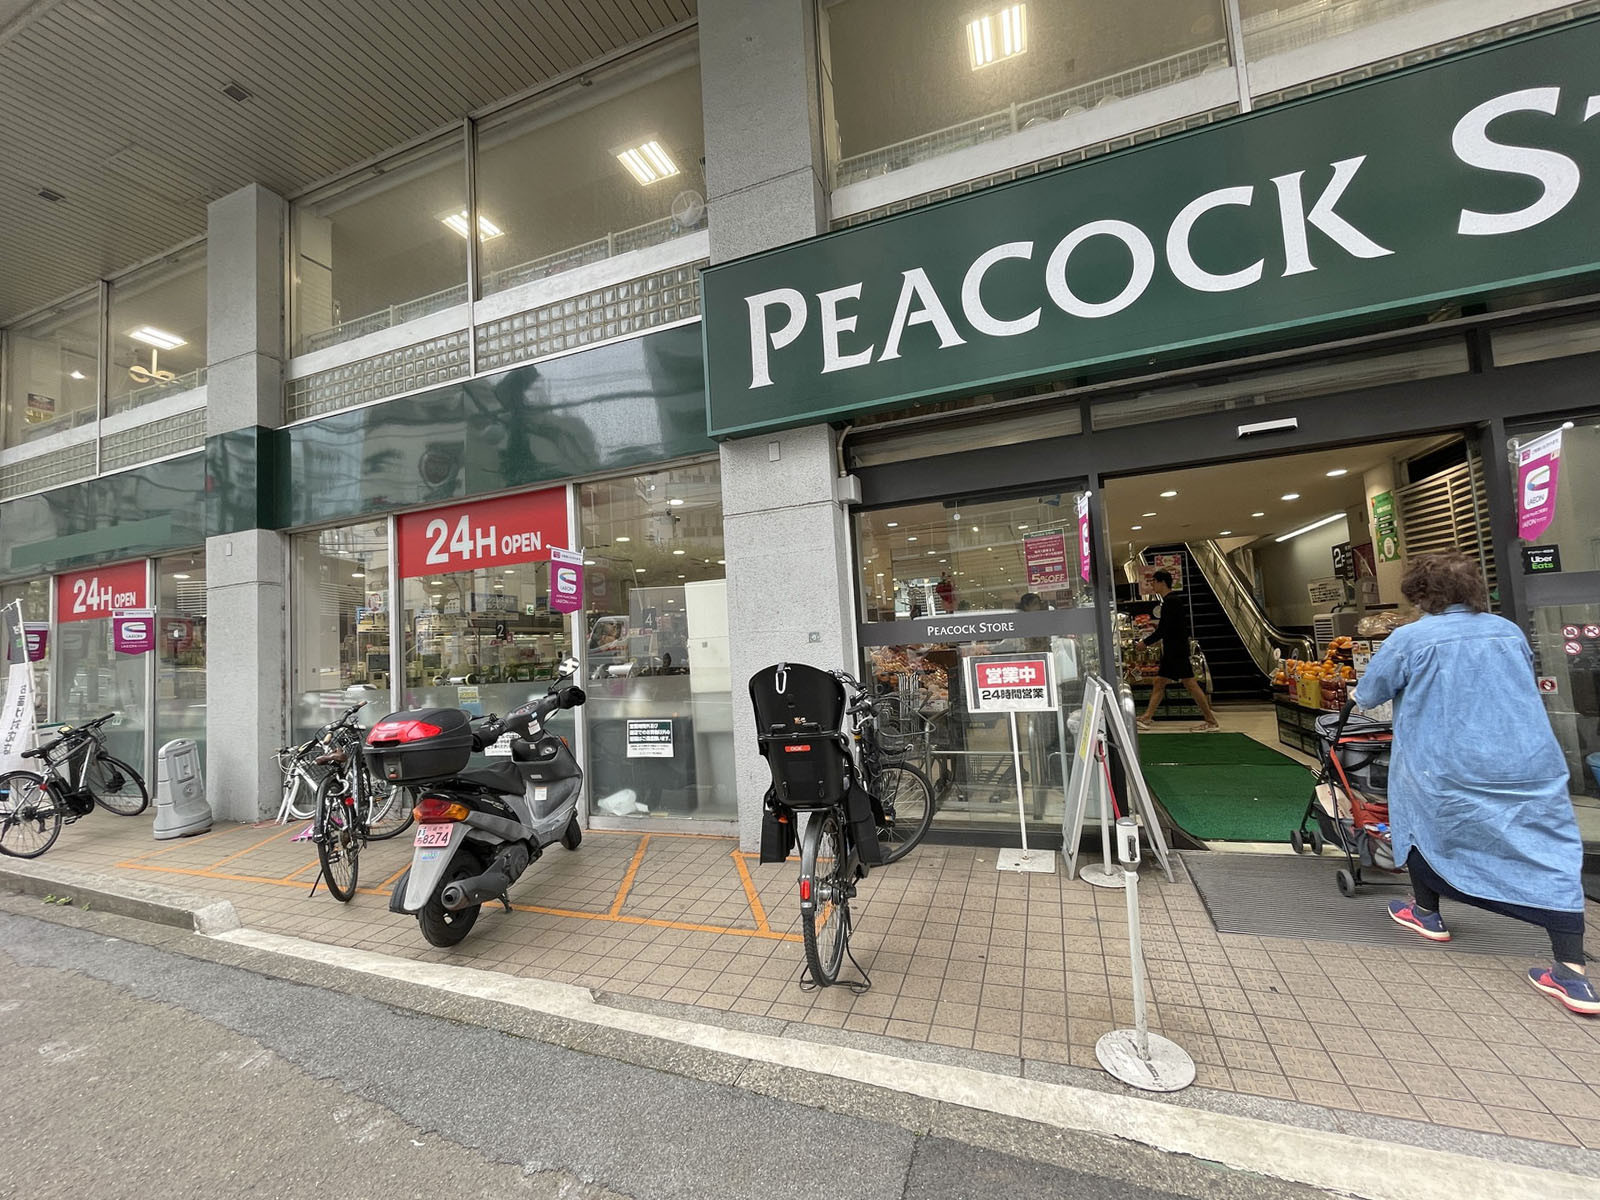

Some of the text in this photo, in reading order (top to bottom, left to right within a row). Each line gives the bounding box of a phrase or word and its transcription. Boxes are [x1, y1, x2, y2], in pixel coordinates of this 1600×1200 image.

[746, 87, 1600, 390] PEACOCK S
[426, 515, 541, 565] 24H OPEN
[1530, 555, 1553, 563] Uber
[1531, 562, 1554, 570] Eats
[1031, 574, 1065, 585] 5%OFF
[73, 577, 136, 613] 24H OPEN
[497, 624, 505, 637] 2
[927, 622, 1015, 636] PEACOCK STORE
[985, 665, 1036, 685] 営業中
[982, 687, 1044, 700] 24時間営業
[422, 832, 449, 844] 8274
